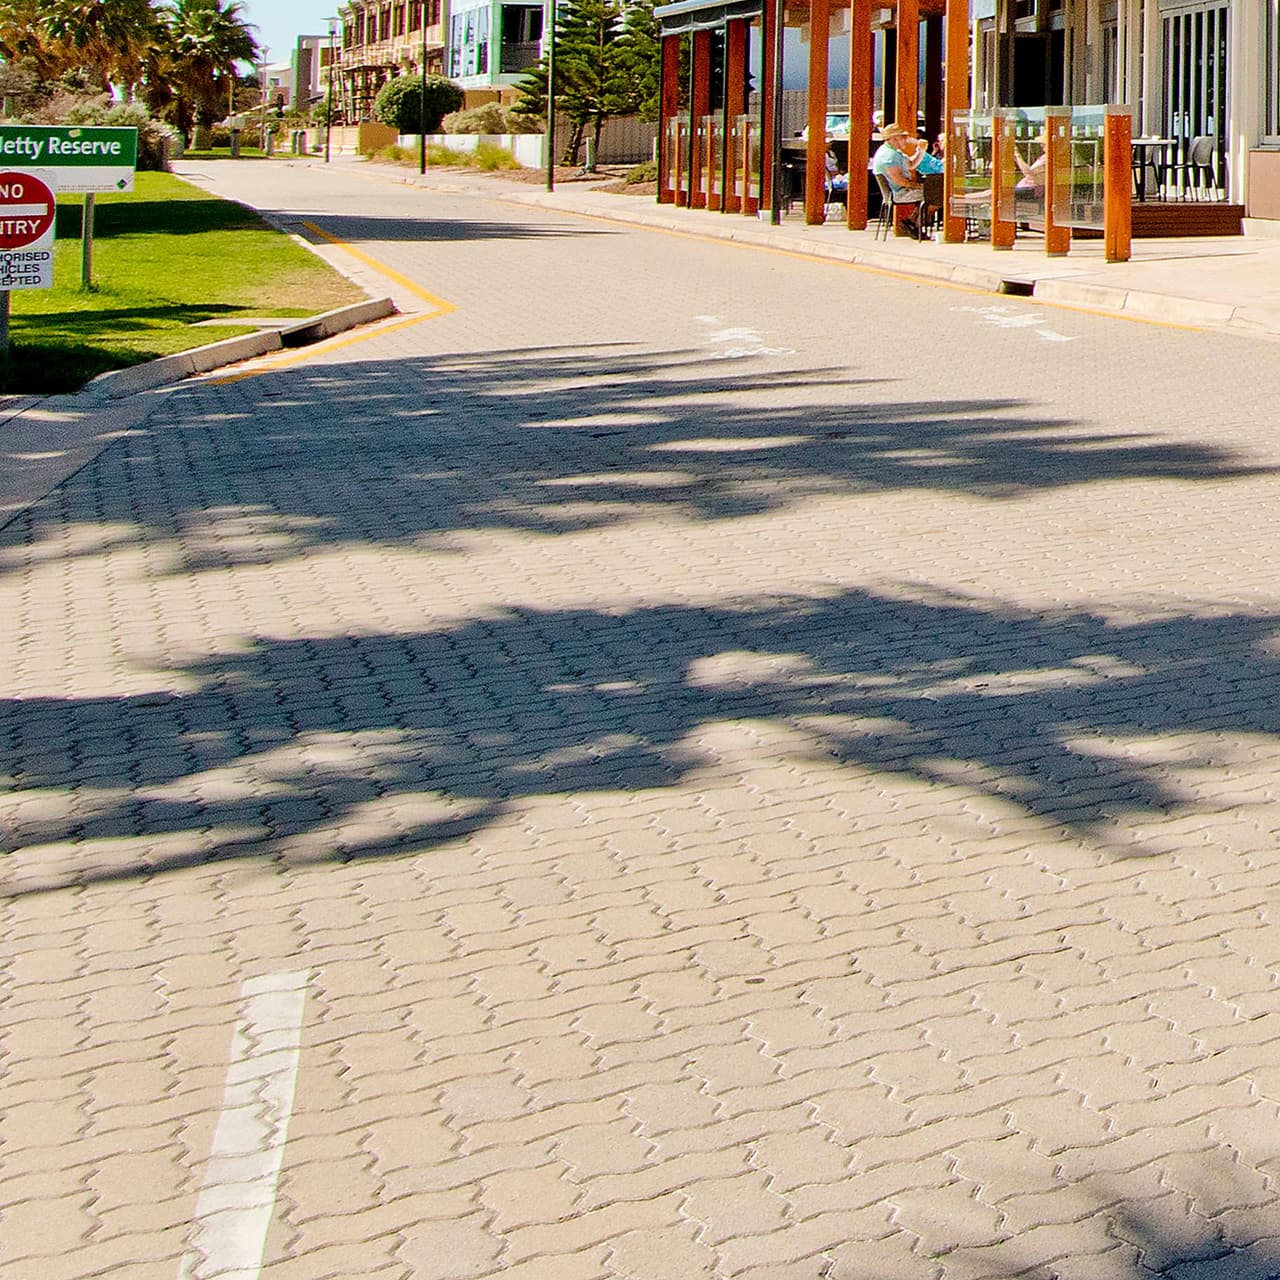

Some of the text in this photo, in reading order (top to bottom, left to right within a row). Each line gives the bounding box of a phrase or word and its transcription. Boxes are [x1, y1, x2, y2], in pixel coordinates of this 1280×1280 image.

[48, 136, 121, 155] Reserve
[0, 219, 41, 235] TRY
[0, 251, 50, 262] ORISED
[0, 263, 40, 274] ICLES
[0, 275, 42, 286] EPTED
